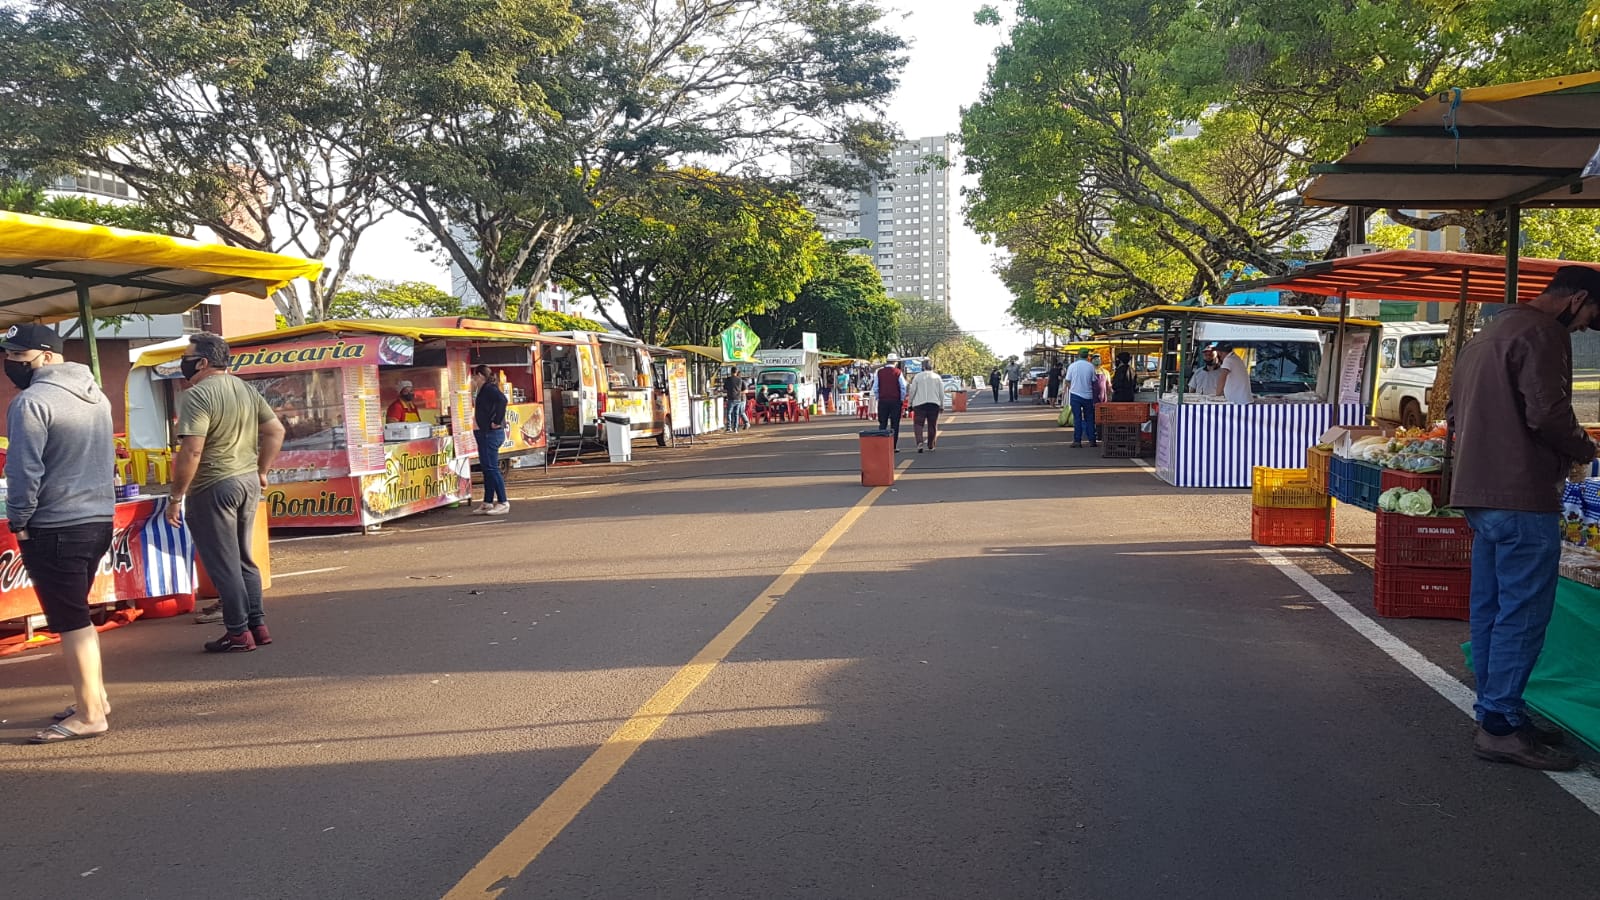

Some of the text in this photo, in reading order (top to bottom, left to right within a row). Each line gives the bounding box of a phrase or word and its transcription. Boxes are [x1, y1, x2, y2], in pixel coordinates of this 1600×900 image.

[227, 341, 365, 371] apiocaria
[400, 450, 448, 476] Tapiocaria
[267, 490, 354, 518] Bonita
[386, 472, 459, 510] Maria Bonita
